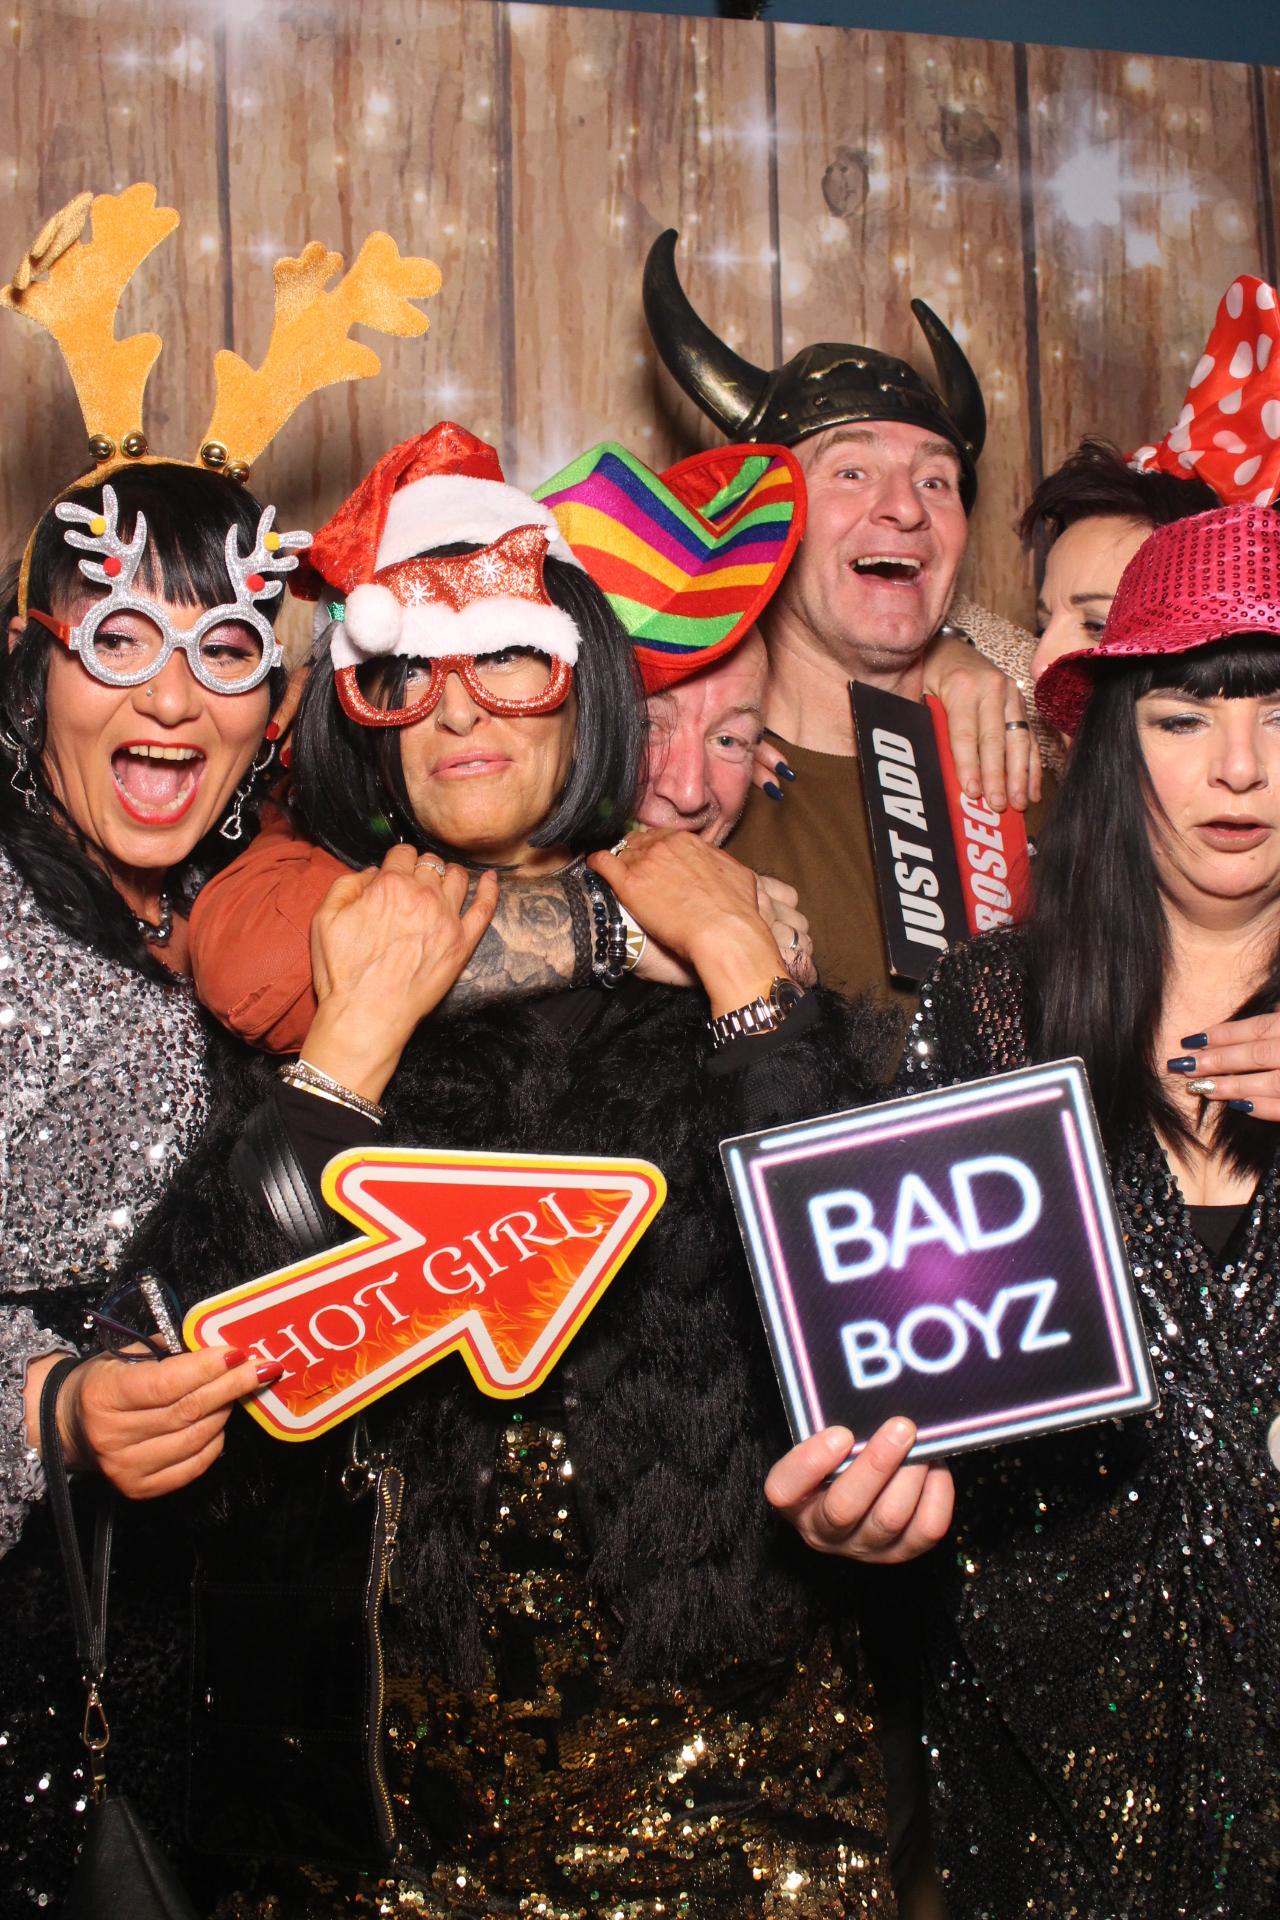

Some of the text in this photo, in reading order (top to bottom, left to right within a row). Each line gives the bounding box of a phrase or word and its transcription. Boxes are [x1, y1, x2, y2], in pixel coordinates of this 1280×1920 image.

[872, 727, 948, 952] JUST ADD
[248, 1192, 604, 1379] HOT GIRL
[808, 1155, 1041, 1283] BAD
[841, 1278, 1071, 1389] BOYZ
